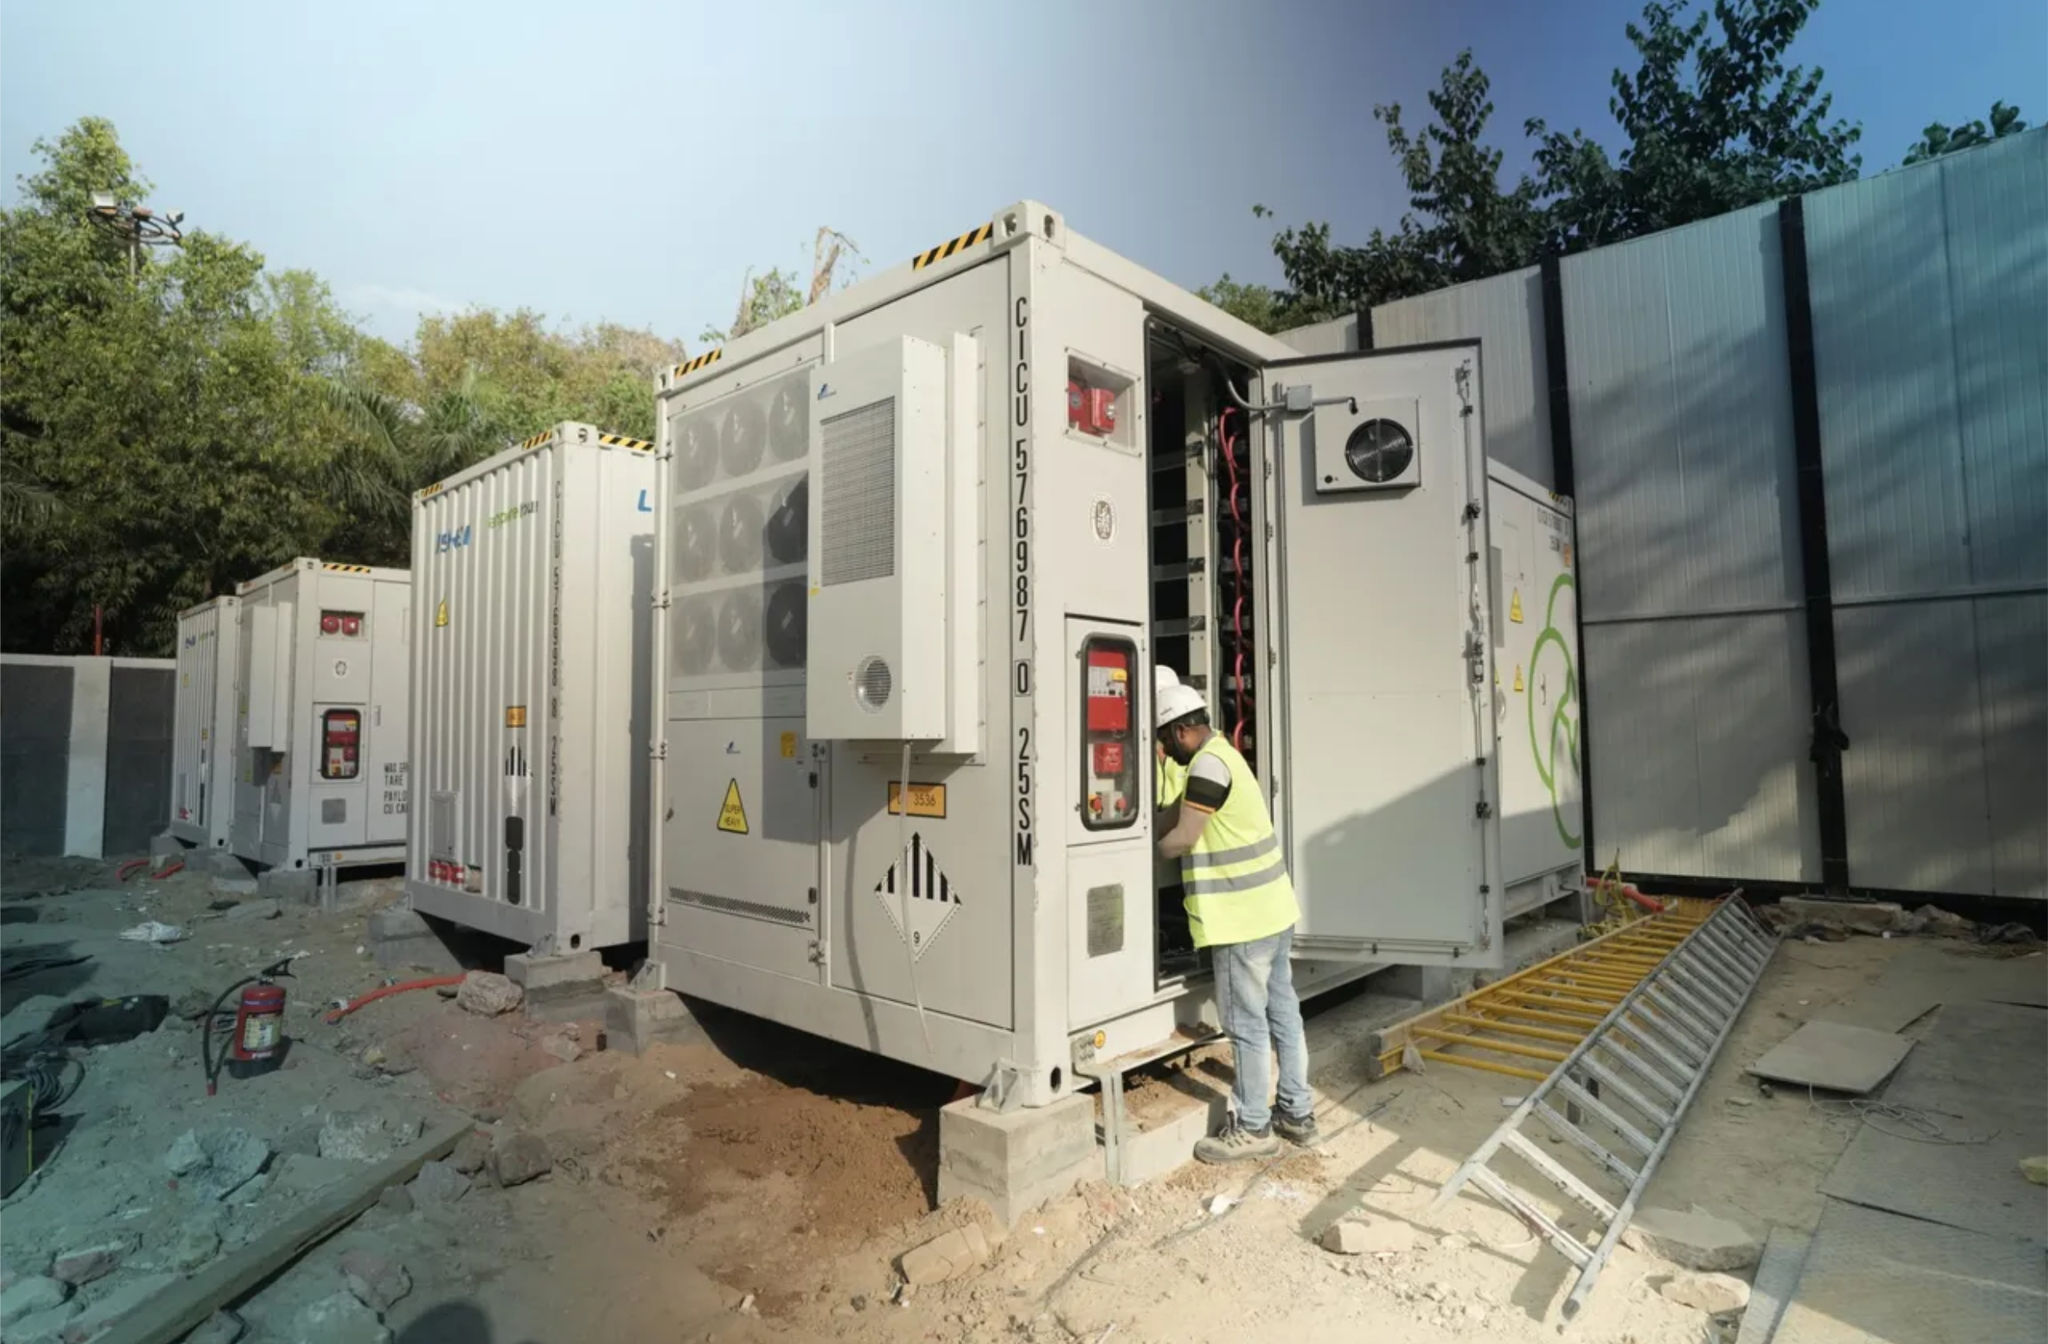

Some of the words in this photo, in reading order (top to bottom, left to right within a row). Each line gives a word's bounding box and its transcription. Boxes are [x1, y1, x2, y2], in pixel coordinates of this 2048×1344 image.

[1016, 297, 1028, 426] CICU
[1016, 438, 1029, 641] 576987
[1017, 661, 1028, 694] 0
[385, 775, 403, 786] TARE
[913, 792, 936, 806] 3536
[1017, 727, 1032, 866] 25SM
[724, 803, 742, 815] SUPER
[724, 816, 741, 827] HEAVY
[913, 930, 920, 944] 9
